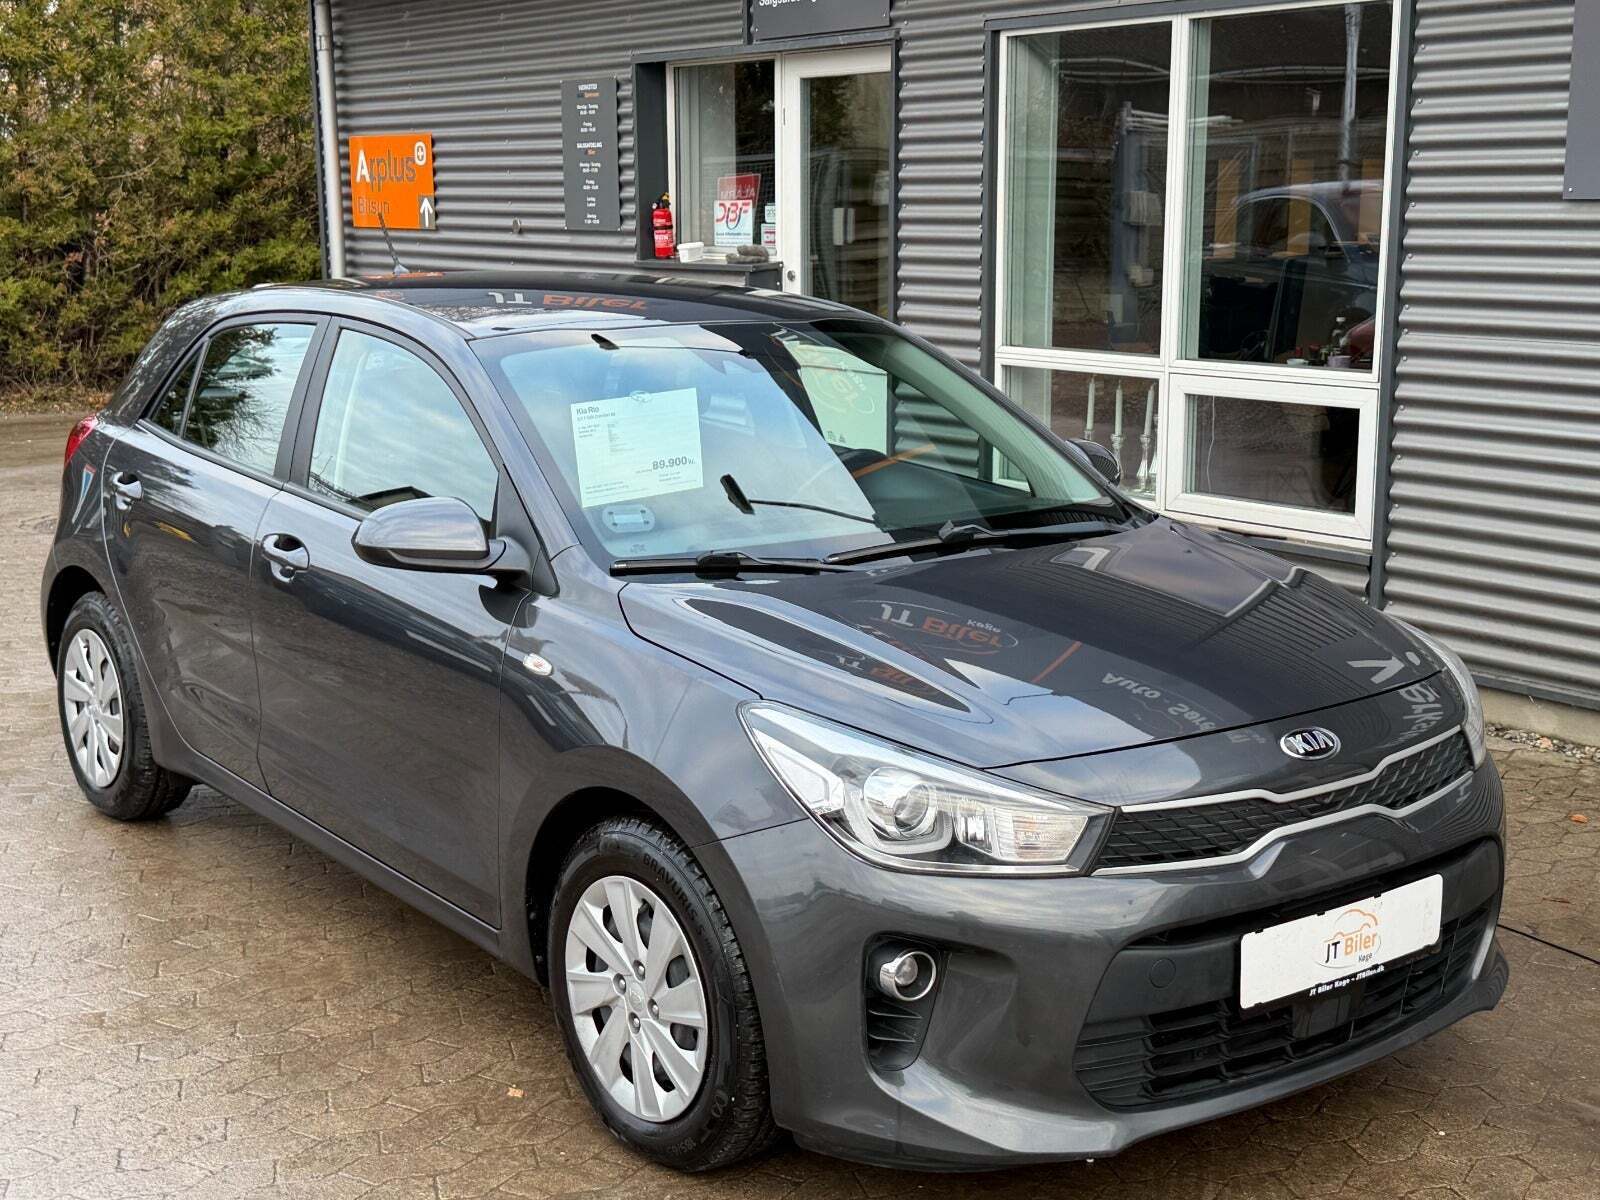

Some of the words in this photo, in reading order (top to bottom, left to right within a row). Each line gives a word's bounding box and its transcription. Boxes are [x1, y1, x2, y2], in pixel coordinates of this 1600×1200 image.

[652, 456, 687, 470] 89.900
[1286, 730, 1334, 754] KIA
[1325, 940, 1341, 963] JT
[1344, 932, 1377, 956] Biler
[1317, 984, 1334, 994] Biler
